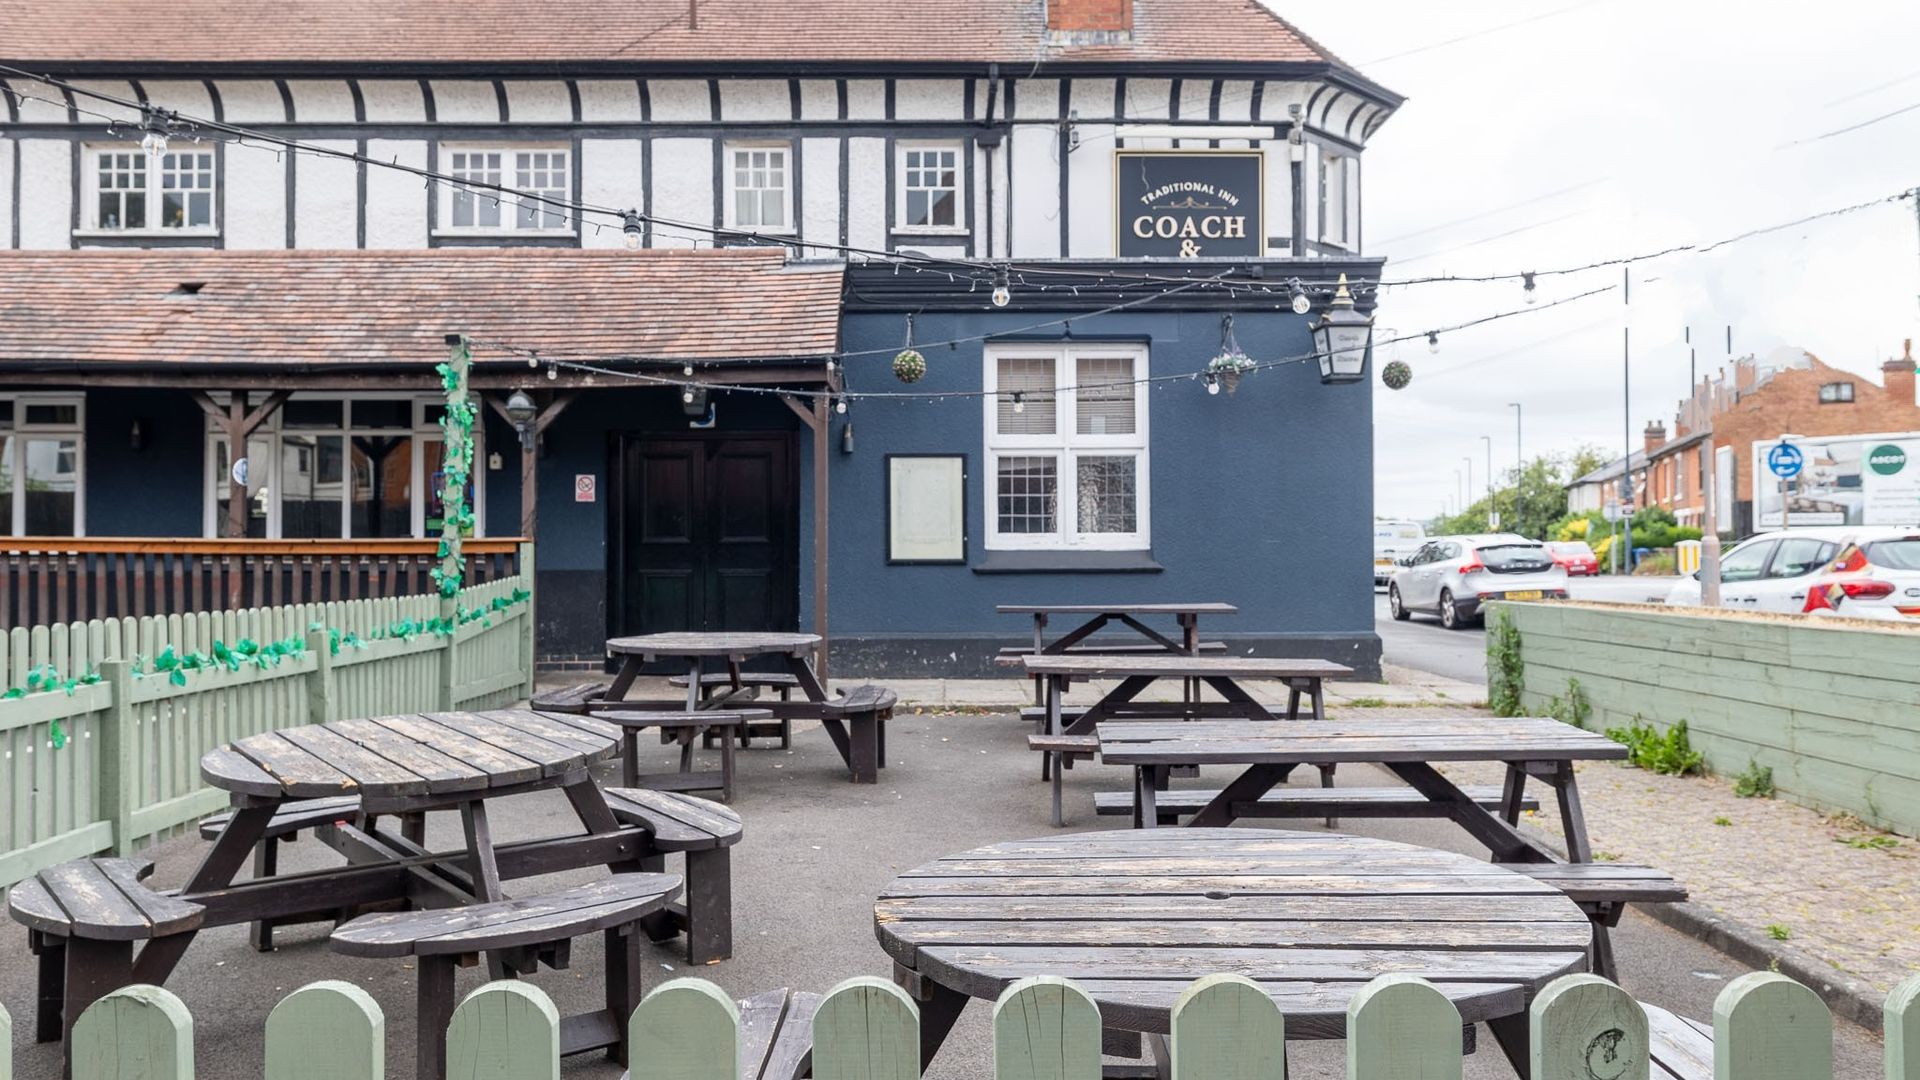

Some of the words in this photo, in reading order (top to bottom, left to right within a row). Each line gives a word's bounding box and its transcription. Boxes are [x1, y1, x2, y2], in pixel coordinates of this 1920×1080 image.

[1140, 181, 1214, 205] TRADITIONAL
[1218, 189, 1239, 206] INN
[1133, 216, 1246, 238] COACH
[1179, 239, 1202, 258] &
